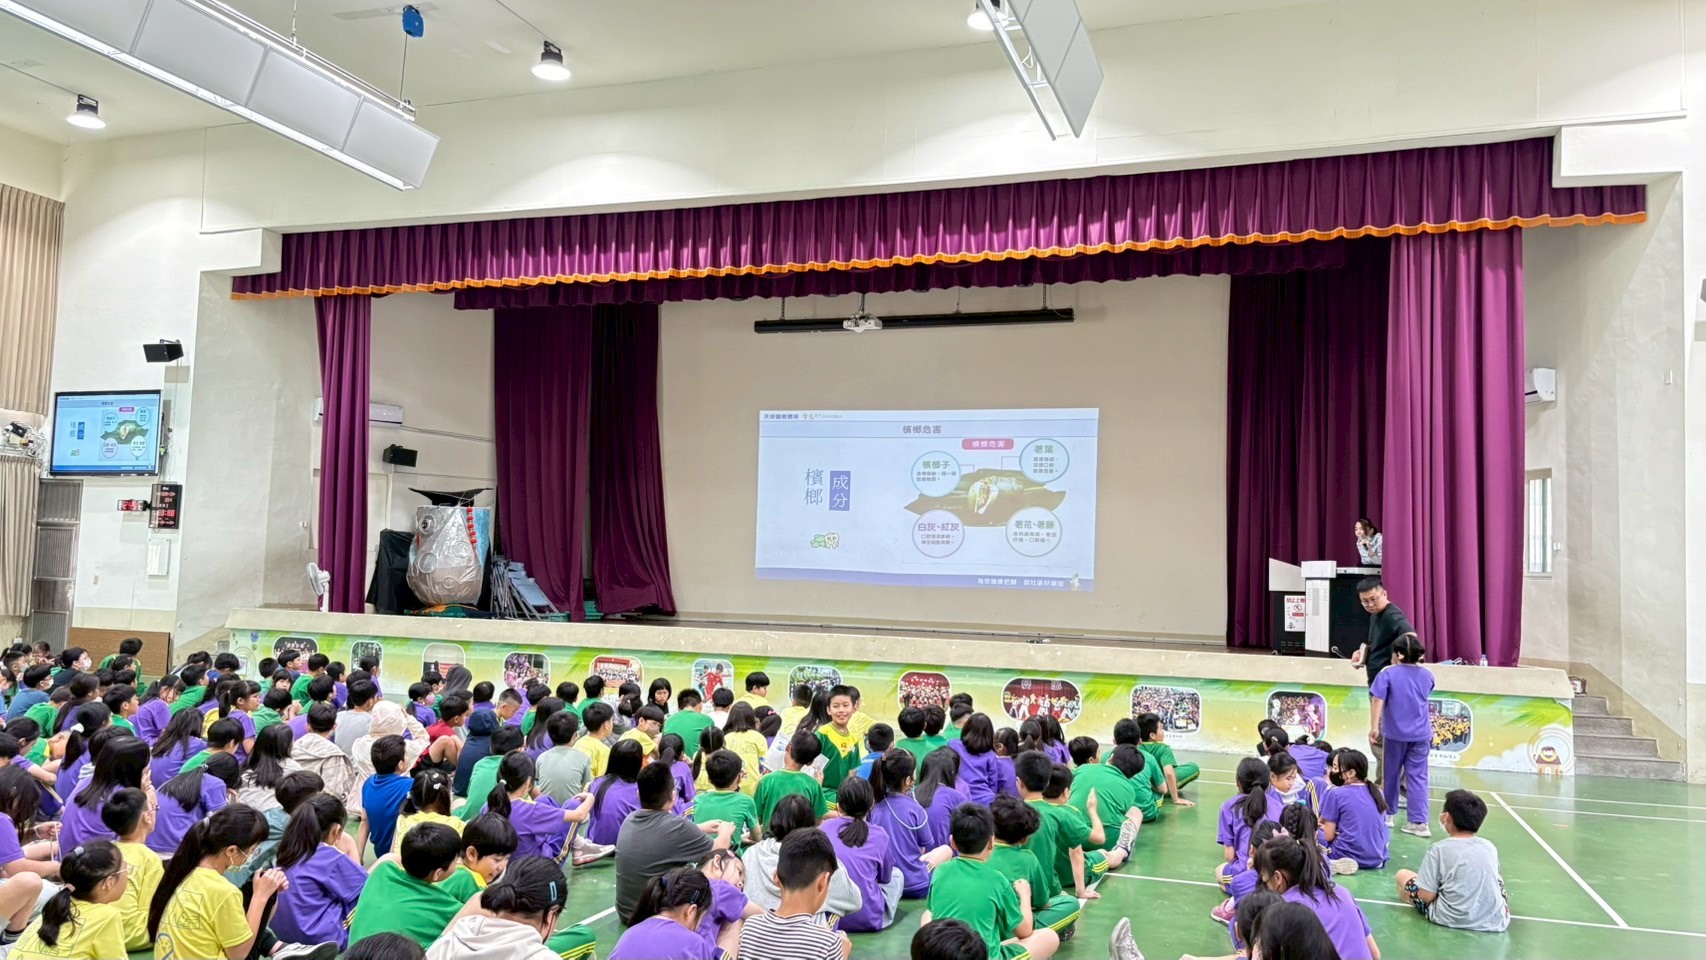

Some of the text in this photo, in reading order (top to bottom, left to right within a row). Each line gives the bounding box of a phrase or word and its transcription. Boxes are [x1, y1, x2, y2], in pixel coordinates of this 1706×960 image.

[903, 425, 942, 435] 檳榔危害
[972, 440, 1005, 448] 檳榔危害
[922, 460, 950, 469] 檳榔子
[804, 468, 824, 506] 檳榔
[832, 474, 849, 508] 成分
[917, 522, 960, 532] 白灰、紅灰
